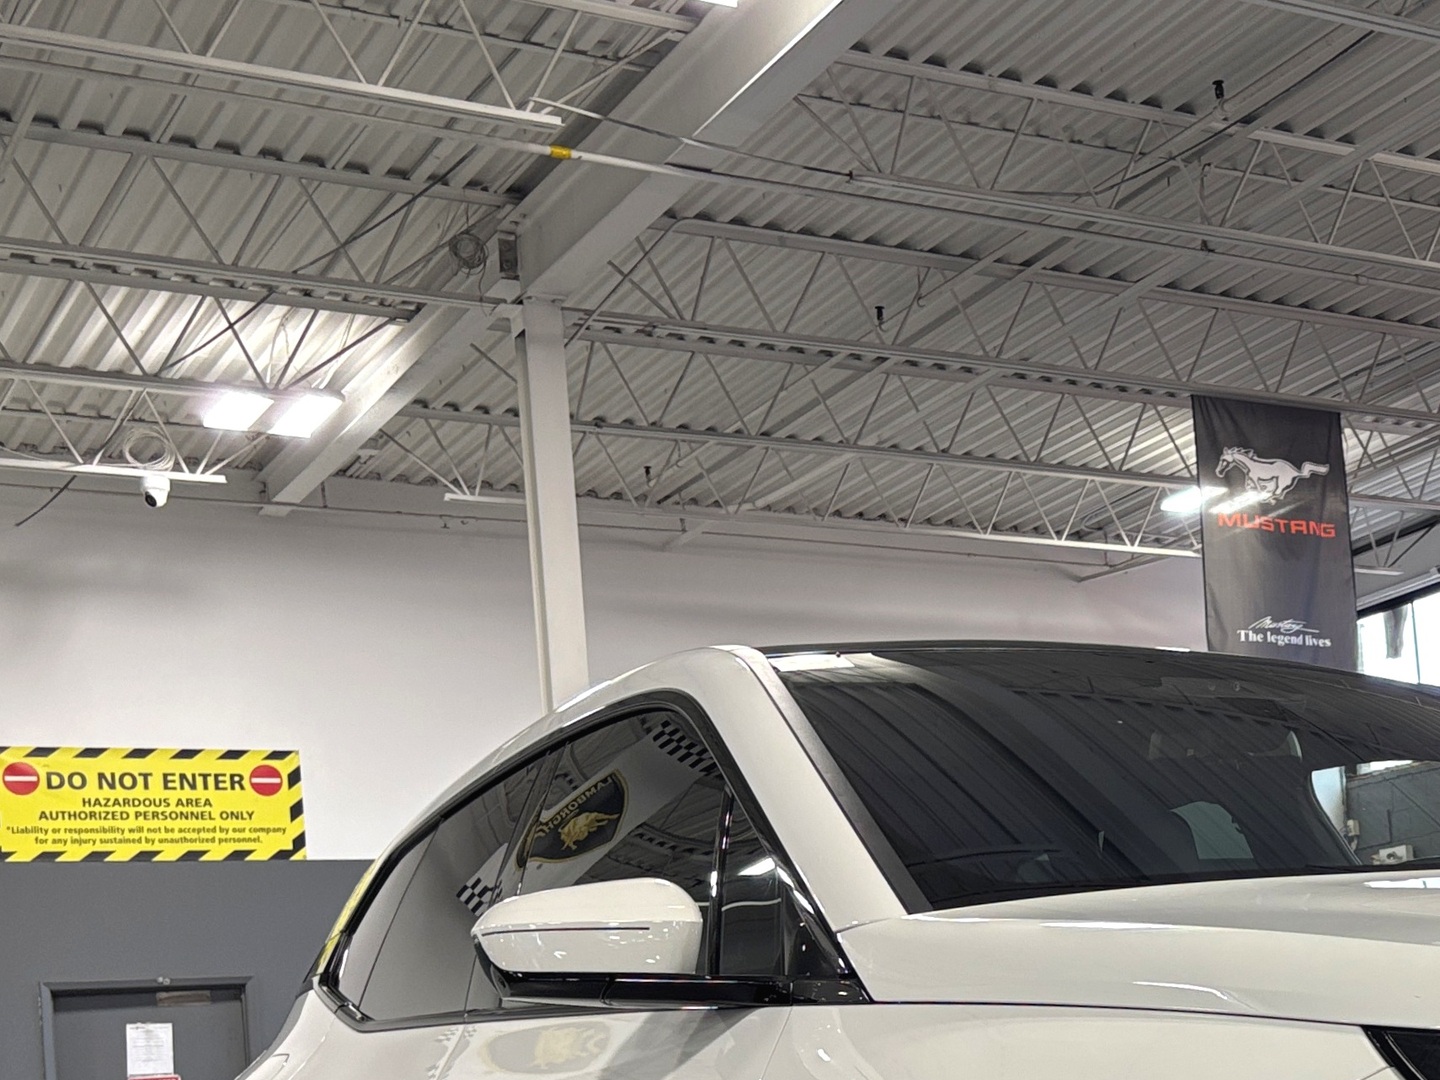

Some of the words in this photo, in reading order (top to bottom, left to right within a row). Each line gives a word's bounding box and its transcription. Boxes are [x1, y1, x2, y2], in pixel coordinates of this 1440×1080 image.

[1216, 512, 1336, 538] MUSTANG
[1236, 629, 1264, 643] The
[1266, 631, 1303, 647] legend
[1305, 635, 1332, 648] lives
[46, 771, 88, 790] DO
[97, 771, 153, 790] NOT
[162, 772, 246, 791] ENTER
[82, 797, 171, 808] HAZARDOUS
[175, 797, 213, 808] AREA
[38, 810, 130, 821] AUTHORIZED
[134, 810, 216, 821] PERSONNEL
[219, 810, 255, 821] ONLY
[64, 826, 125, 836] responsibility
[128, 826, 144, 834] will
[147, 826, 162, 834] not
[164, 826, 175, 834] be
[178, 826, 217, 836] accepted
[219, 826, 230, 835] by
[248, 827, 287, 836] company
[35, 836, 49, 844] for
[51, 838, 67, 847] any
[70, 836, 97, 847] injury
[99, 836, 143, 845] sustained
[145, 836, 156, 846] by
[158, 836, 216, 844] unauthorized
[218, 836, 263, 845] personnel.
